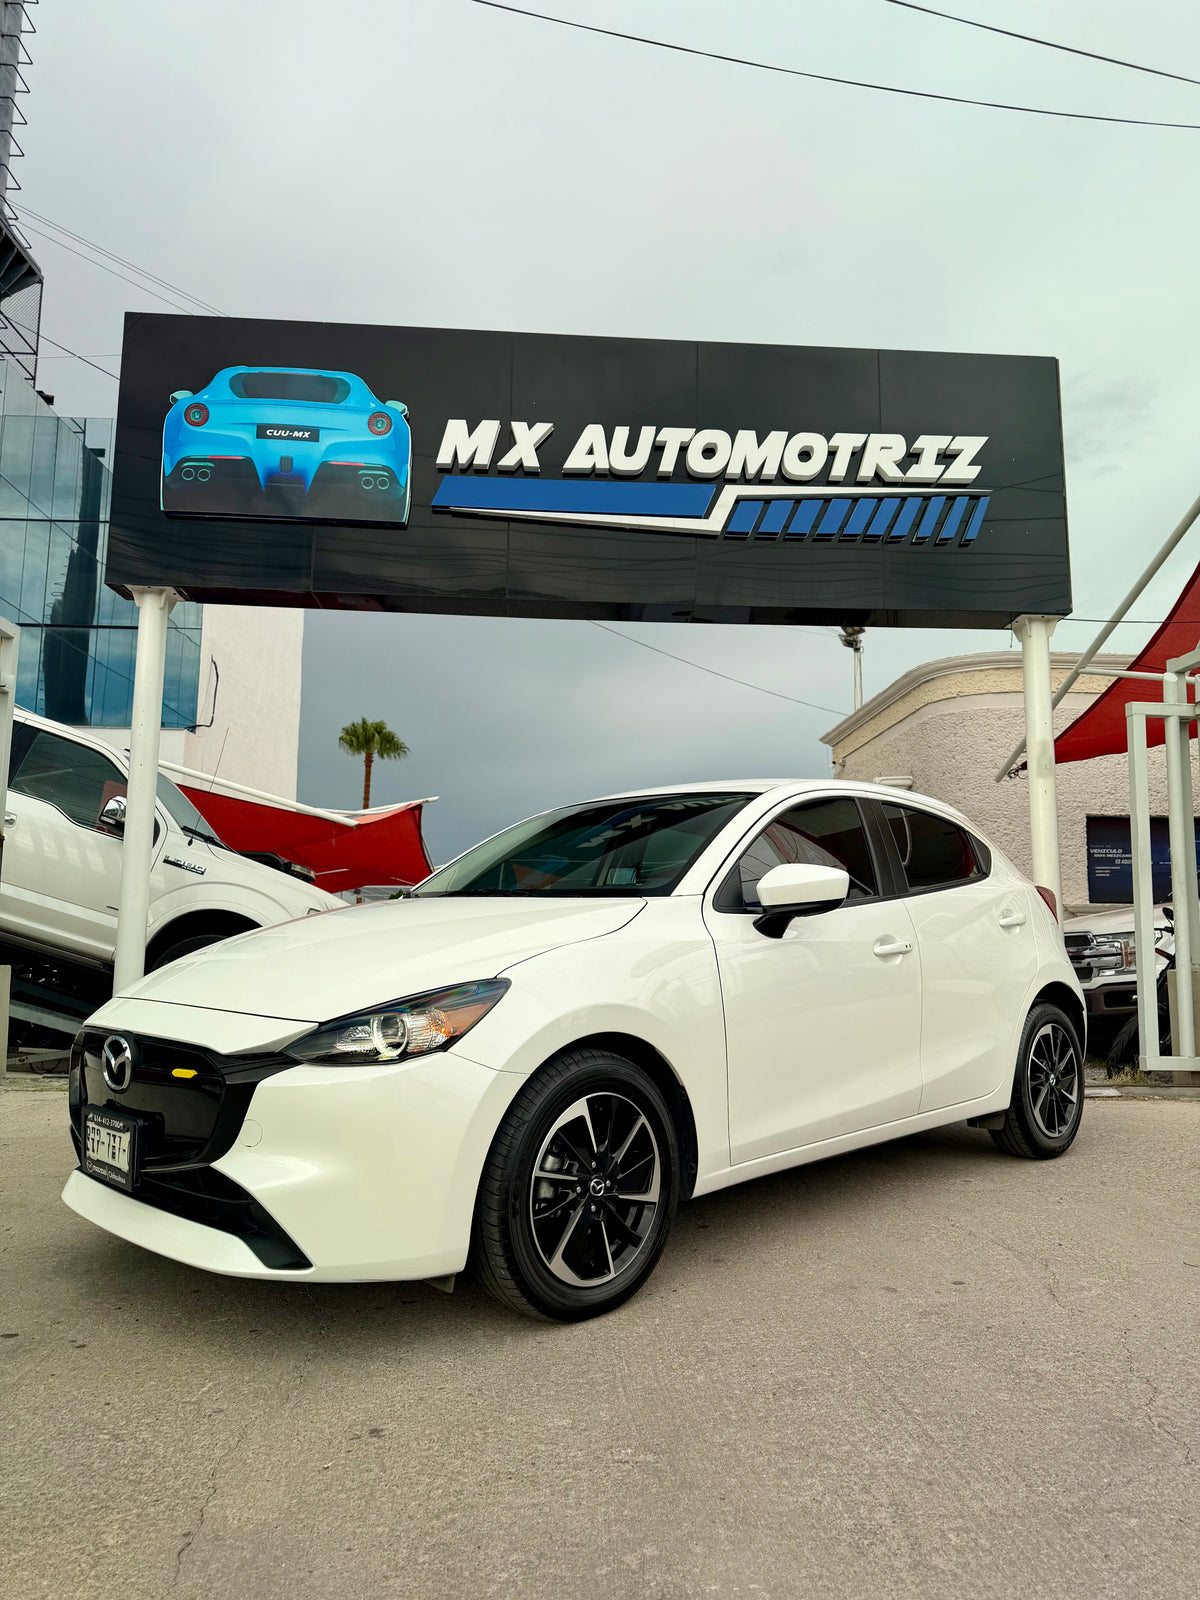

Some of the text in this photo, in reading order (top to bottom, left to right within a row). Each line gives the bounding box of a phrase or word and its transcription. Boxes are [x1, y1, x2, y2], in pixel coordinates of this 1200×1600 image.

[266, 429, 311, 438] CUU-MX
[436, 418, 989, 485] MX AUTOMOTRIZ
